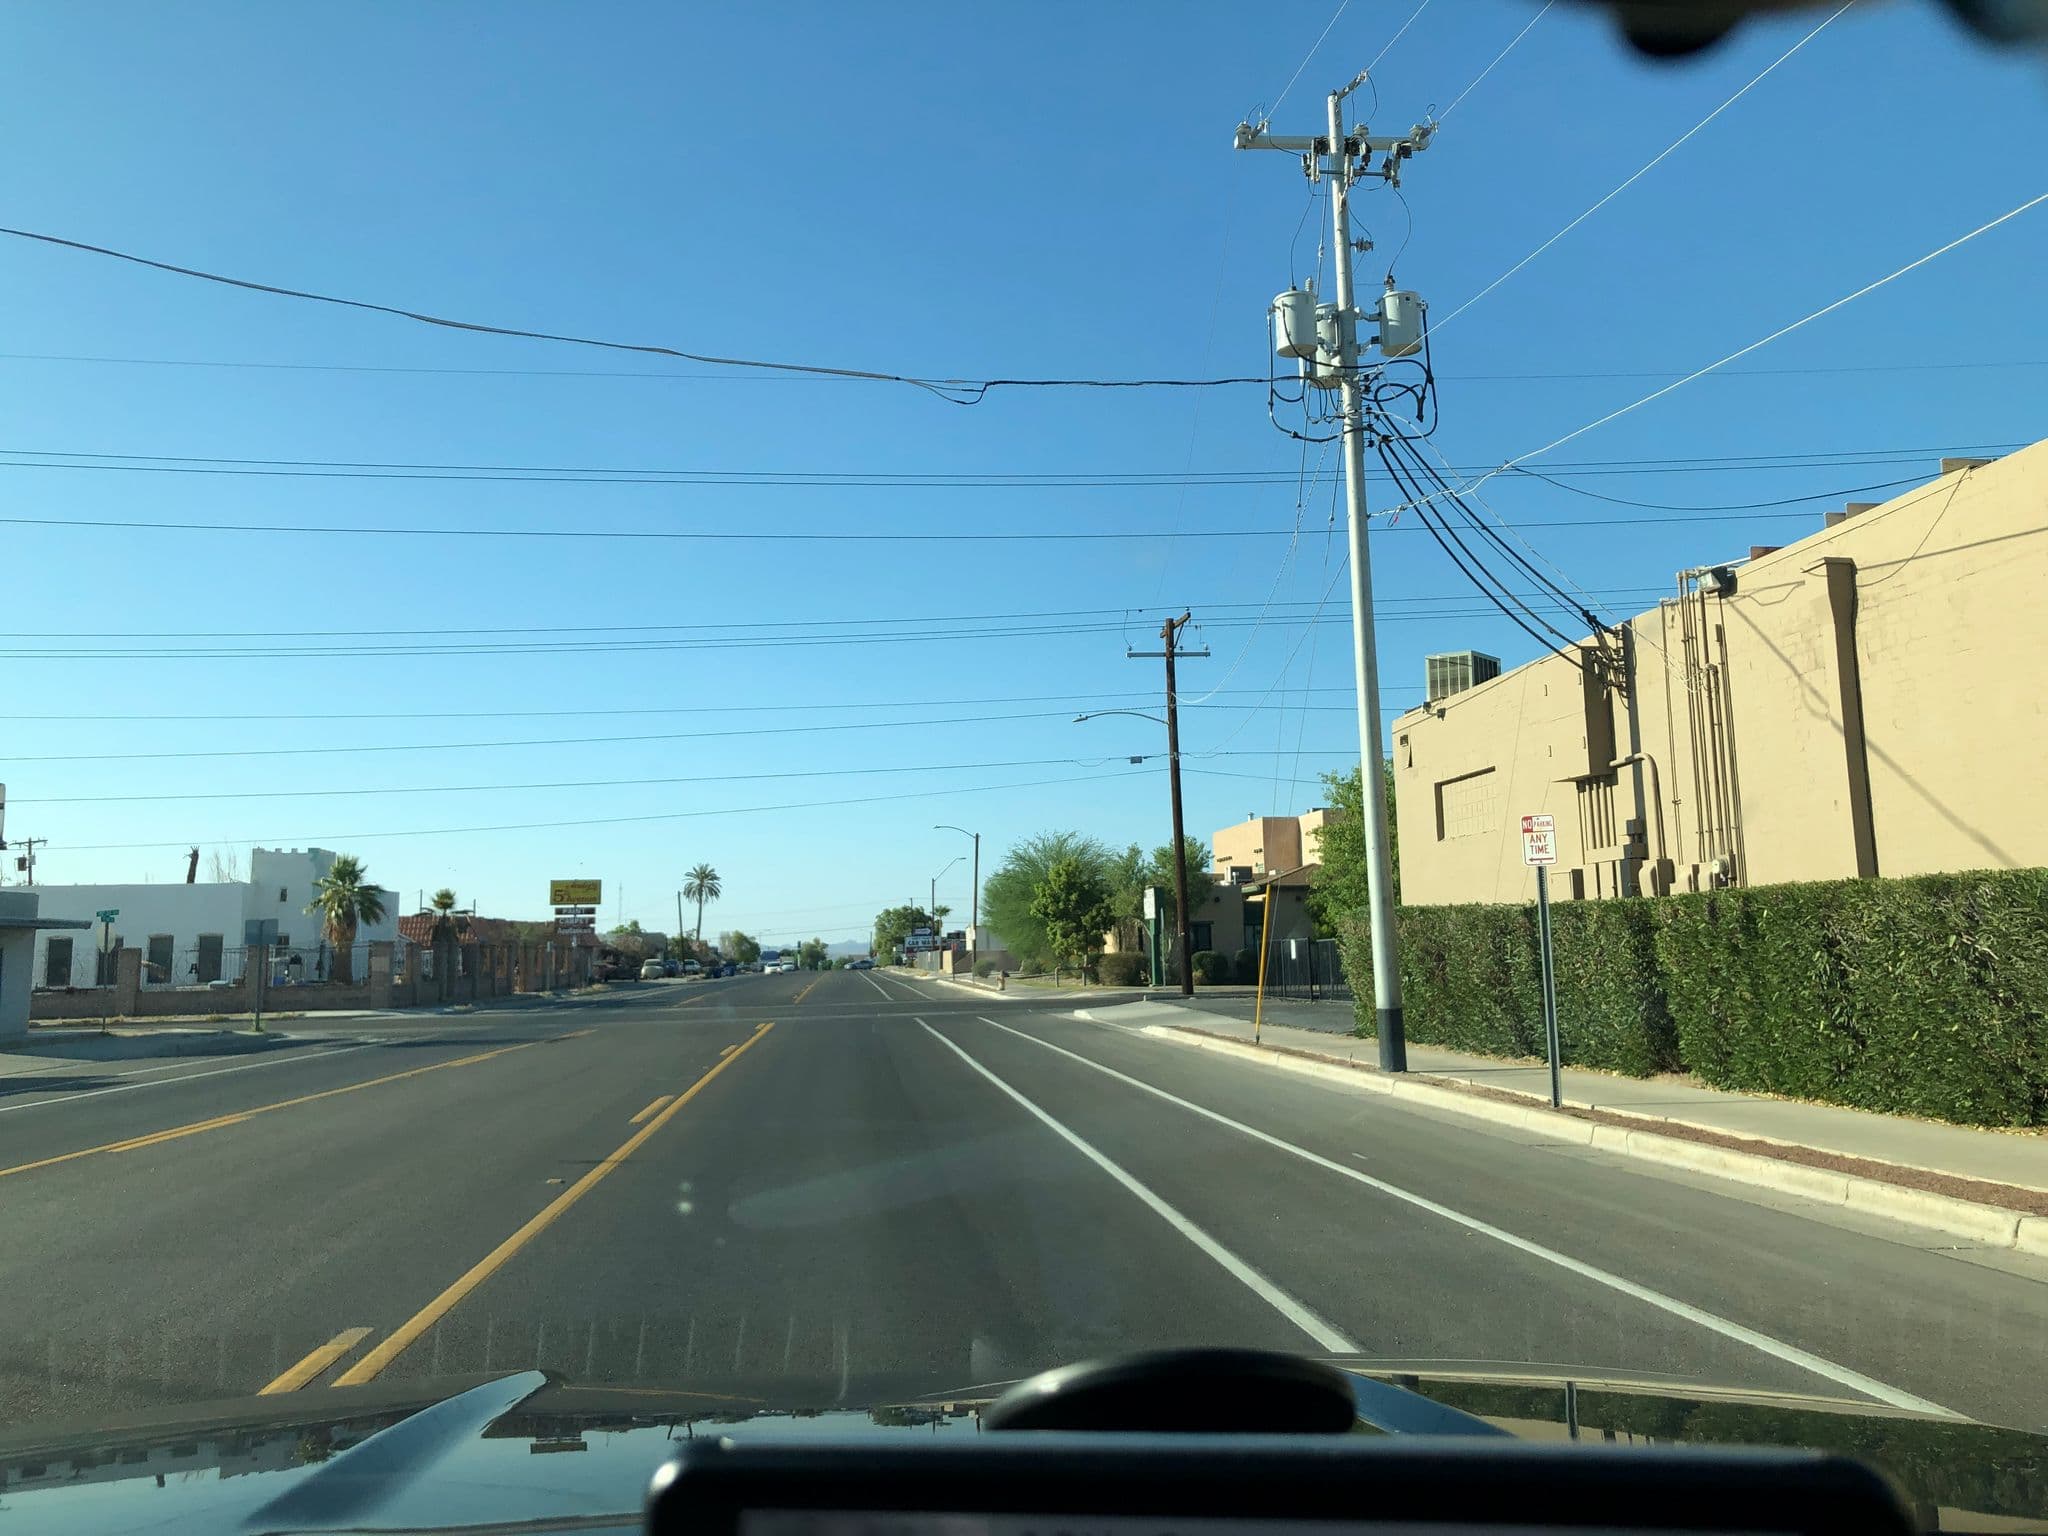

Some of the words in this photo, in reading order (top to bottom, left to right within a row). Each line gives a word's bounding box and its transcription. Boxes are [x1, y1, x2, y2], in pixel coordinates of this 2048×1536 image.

[1522, 820, 1533, 830] NO
[1530, 833, 1548, 844] ANY
[1530, 844, 1550, 855] TIME
